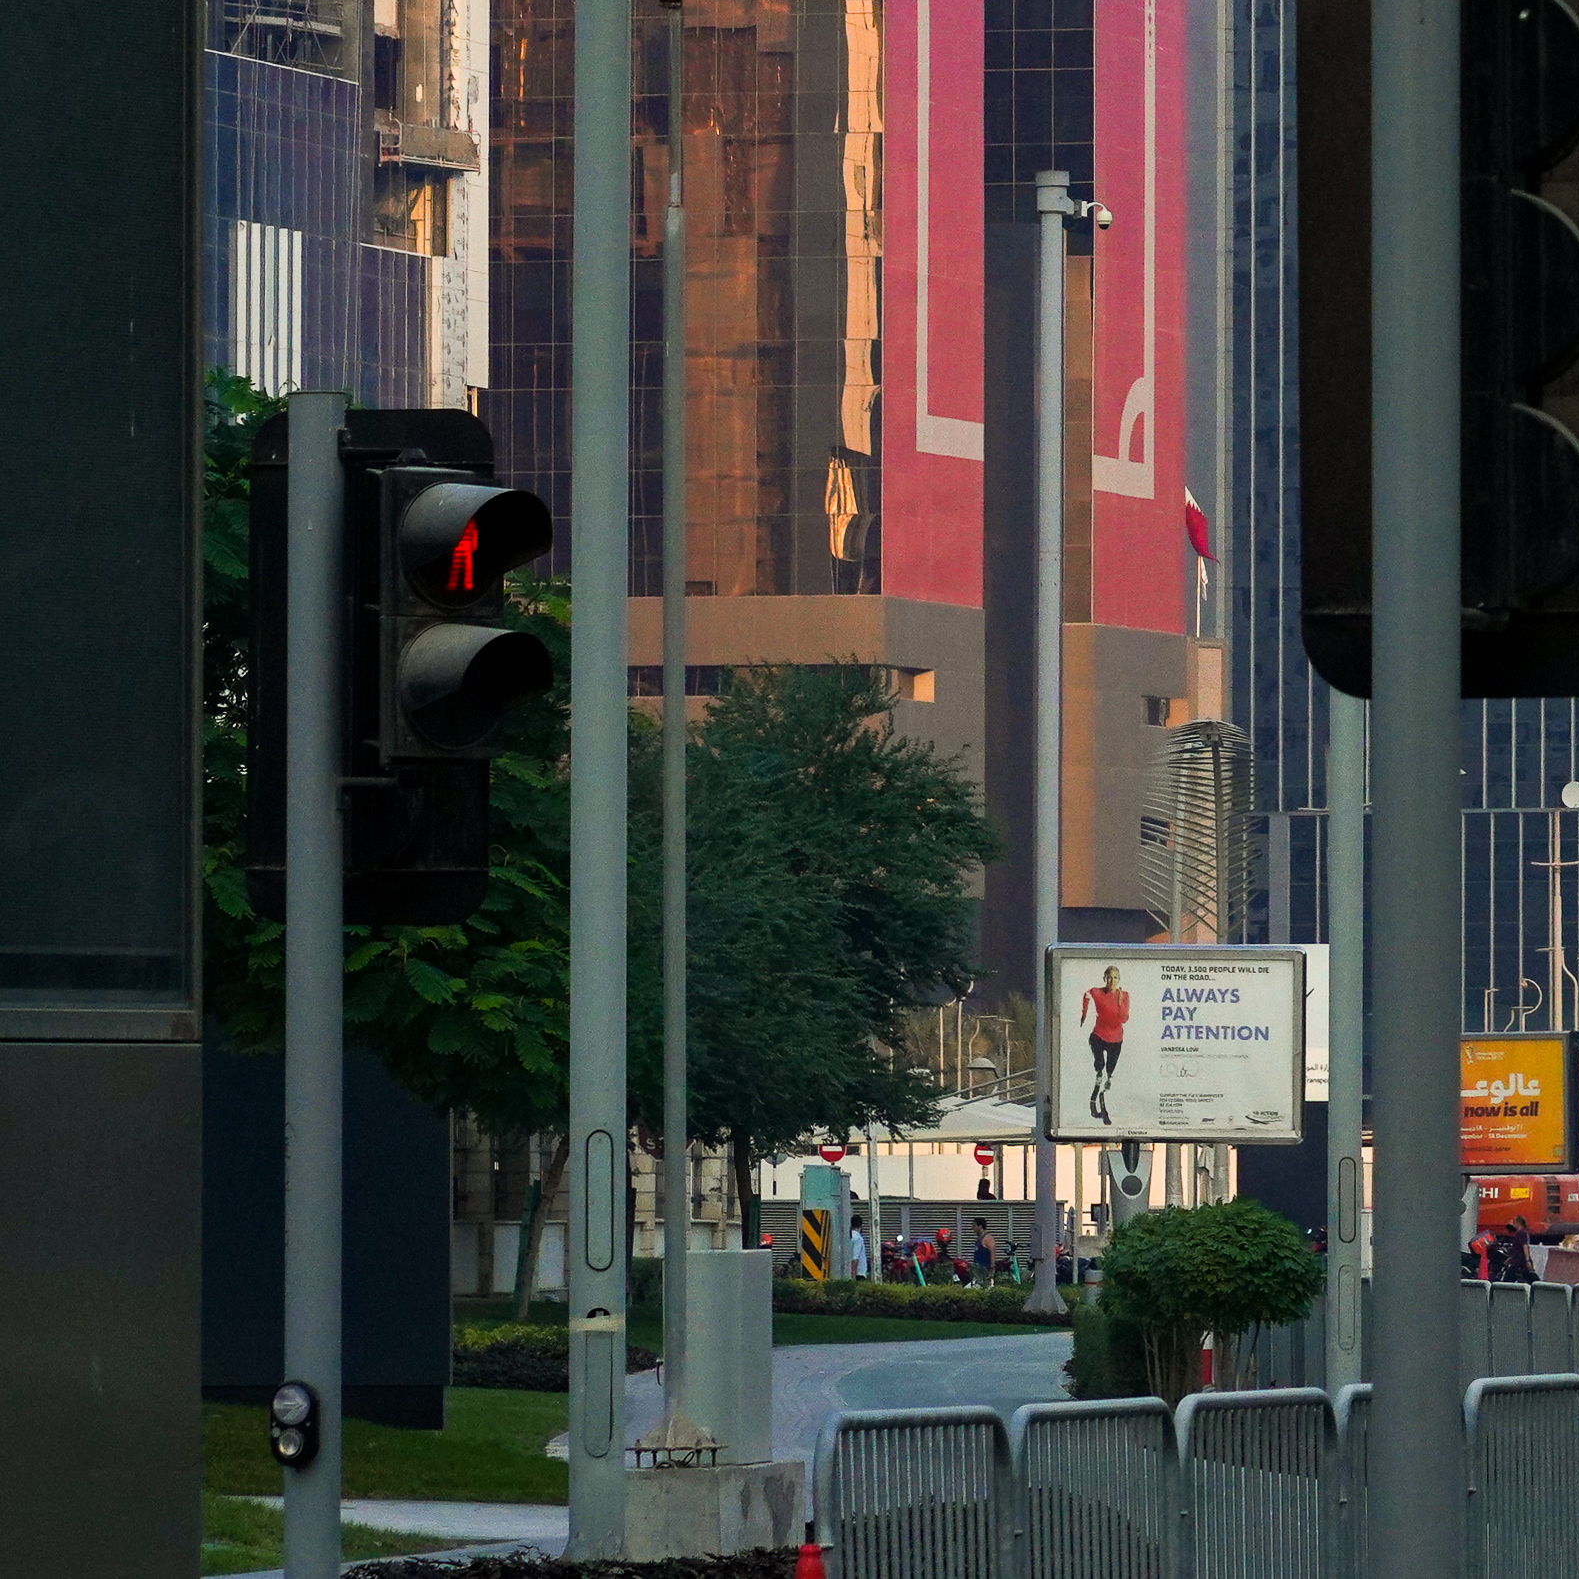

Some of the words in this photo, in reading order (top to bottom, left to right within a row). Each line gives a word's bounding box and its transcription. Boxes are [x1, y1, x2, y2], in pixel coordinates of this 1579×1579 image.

[1237, 966, 1257, 974] WILL
[1161, 987, 1241, 1004] ALWAYS
[1161, 1006, 1197, 1022] PAY
[1160, 1024, 1270, 1041] ATTENTION
[1460, 1072, 1541, 1105] عالوع
[1463, 1105, 1502, 1118] now
[1503, 1101, 1518, 1118] is
[1519, 1100, 1540, 1118] all
